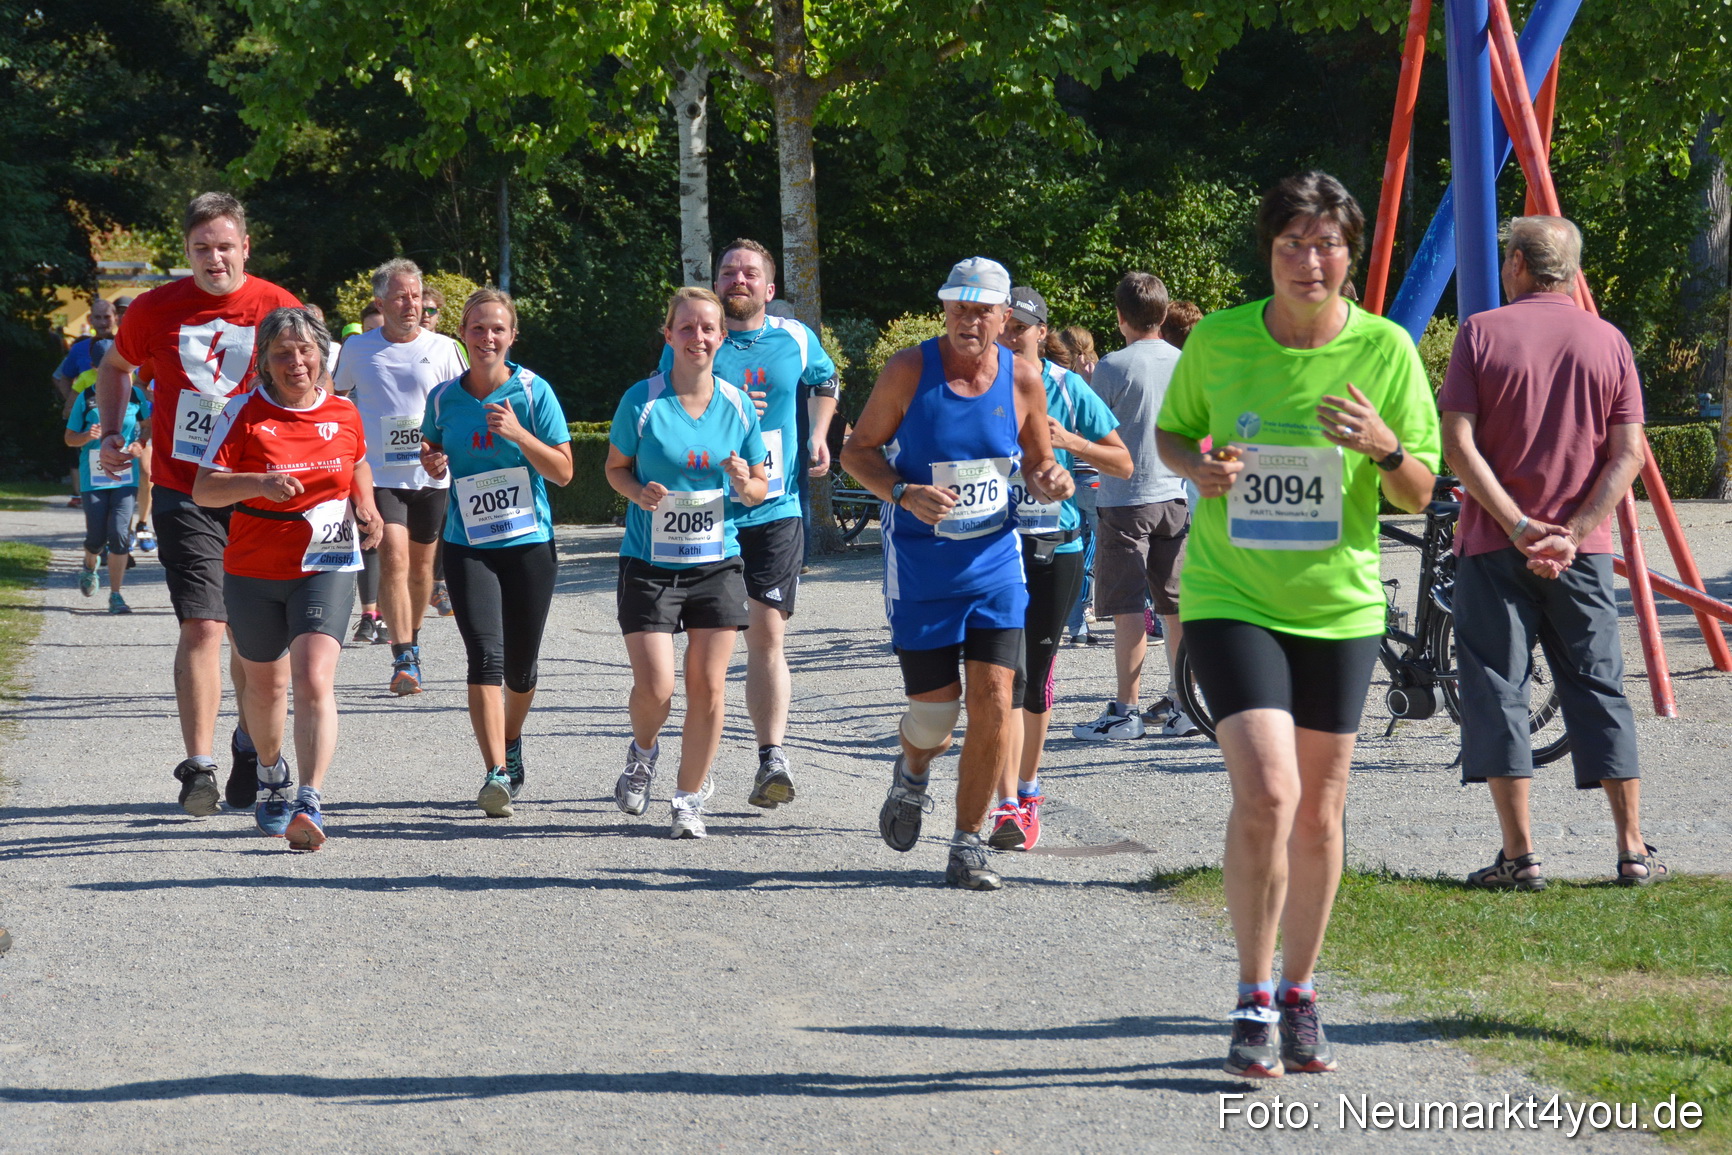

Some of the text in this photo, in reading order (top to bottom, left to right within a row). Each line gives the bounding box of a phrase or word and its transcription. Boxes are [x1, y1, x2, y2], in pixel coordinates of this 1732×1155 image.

[185, 411, 217, 435] 24
[1259, 454, 1308, 467] BOCK
[958, 466, 991, 477] BOCK
[476, 475, 507, 489] BOCK
[1244, 474, 1324, 505] 3094
[469, 486, 519, 516] 2087
[675, 498, 706, 506] BOCK
[494, 511, 514, 519] Neumarkt
[491, 521, 513, 534] Steffi
[664, 511, 714, 533] 2085
[960, 519, 991, 531] Johann
[679, 546, 702, 555] Kathi
